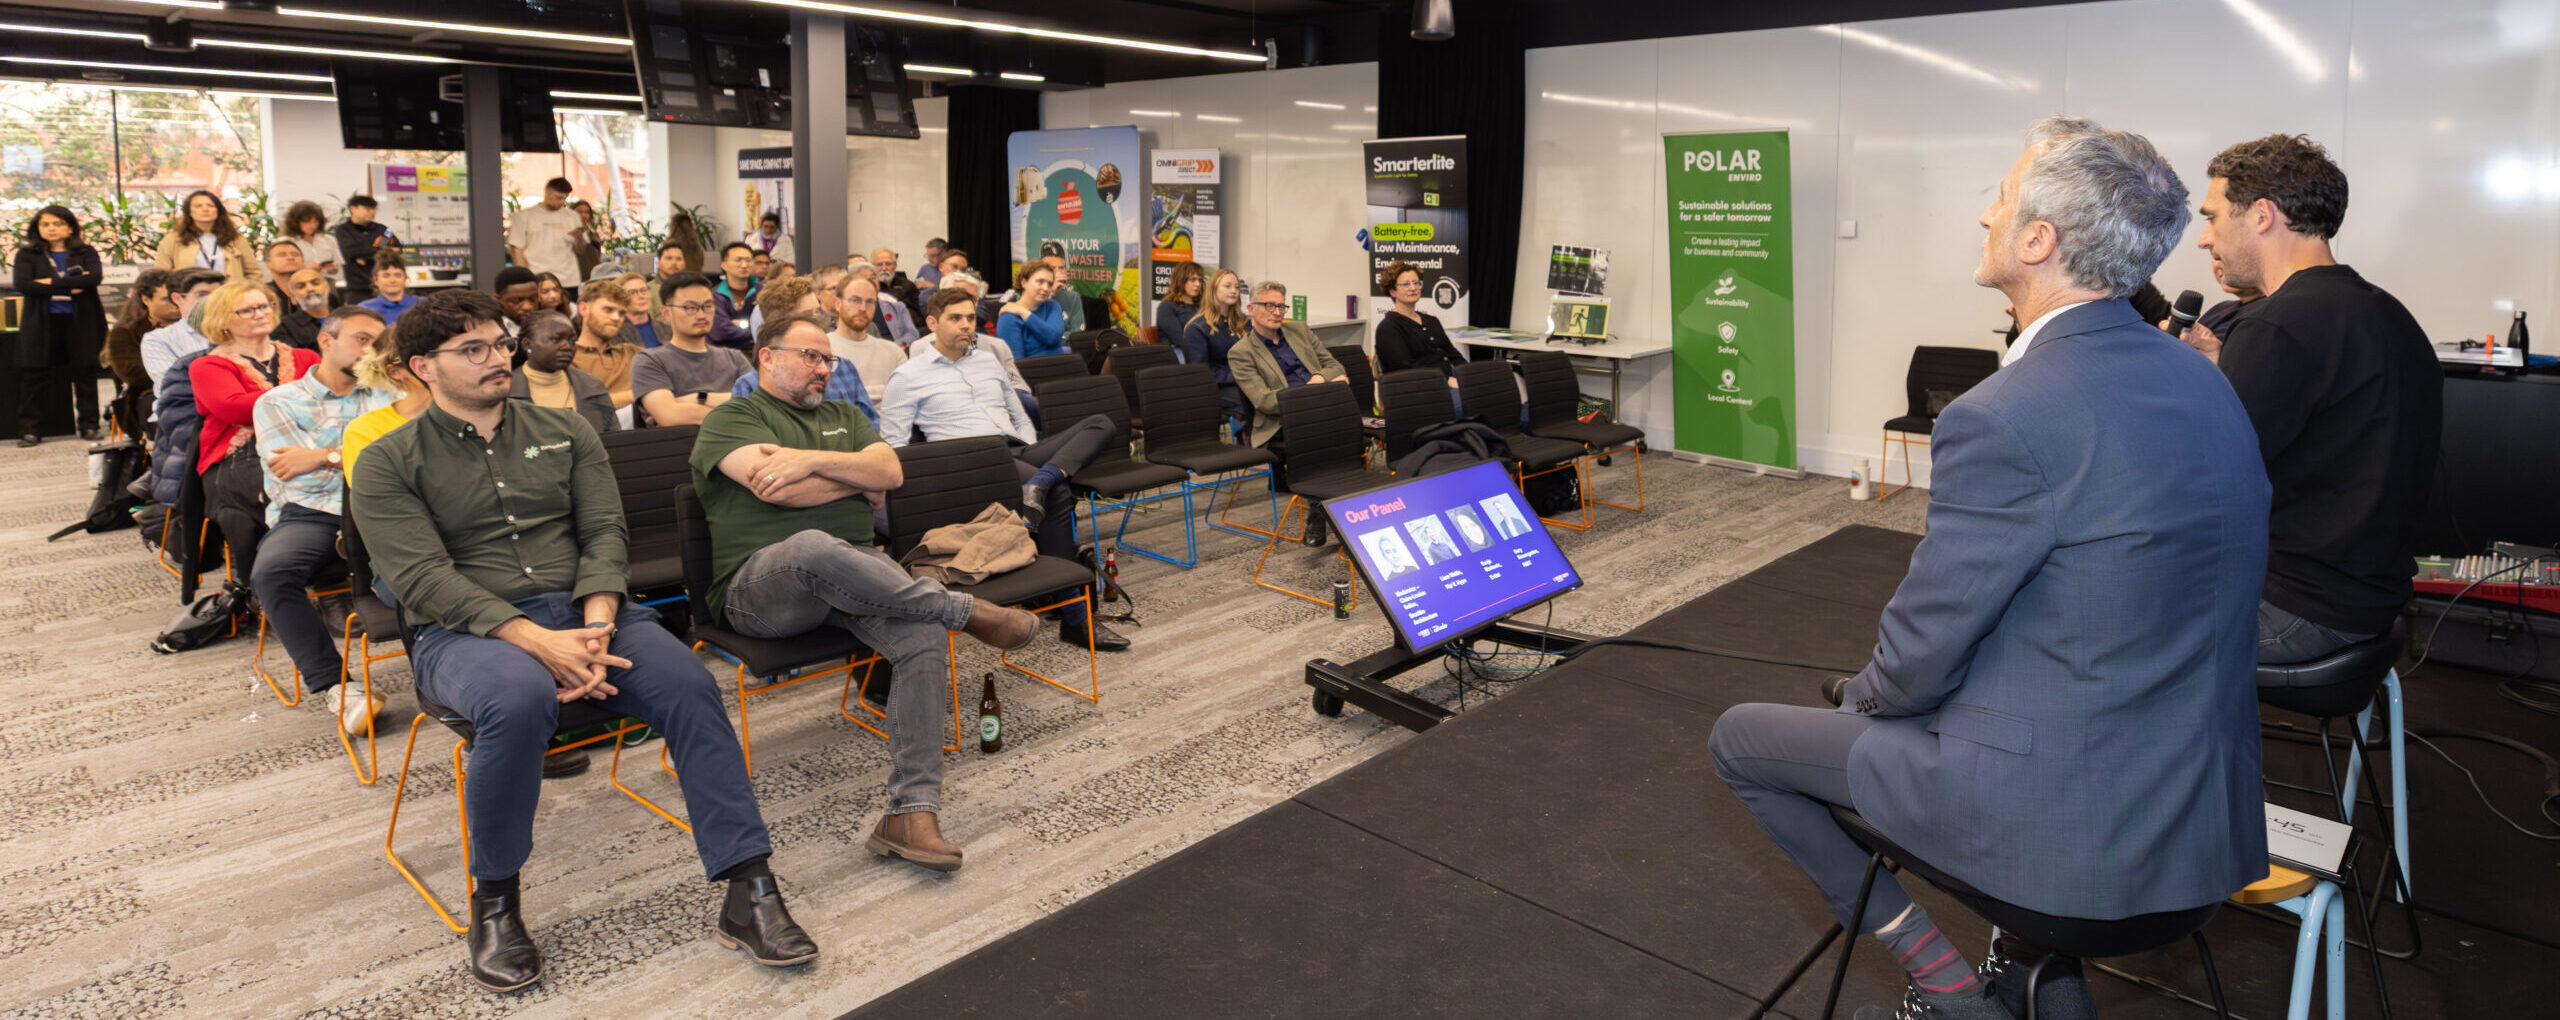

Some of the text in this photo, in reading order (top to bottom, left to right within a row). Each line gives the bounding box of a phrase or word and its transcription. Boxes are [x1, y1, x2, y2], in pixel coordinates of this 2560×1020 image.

[1373, 154, 1455, 172] Smarterlite
[1684, 149, 1761, 172] POLAR
[1728, 173, 1762, 182] ENVIRO
[1679, 201, 1772, 210] Sustainable solutions
[1680, 212, 1692, 221] for
[1703, 212, 1724, 221] safer
[1727, 213, 1771, 222] tomorrow
[1374, 226, 1432, 238] Battery-free,
[1070, 239, 1099, 250] YOUR
[1691, 236, 1712, 245] Create
[1740, 239, 1761, 248] impact
[1374, 242, 1460, 255] Low Maintenance,
[1684, 246, 1693, 255] for
[1694, 247, 1720, 256] business
[1735, 249, 1769, 260] community
[1069, 254, 1105, 266] WASTE
[1705, 297, 1750, 309] Sustainability
[1718, 346, 1738, 356] Safety
[1708, 394, 1752, 405] Local Content
[1345, 497, 1406, 523] Our Panel
